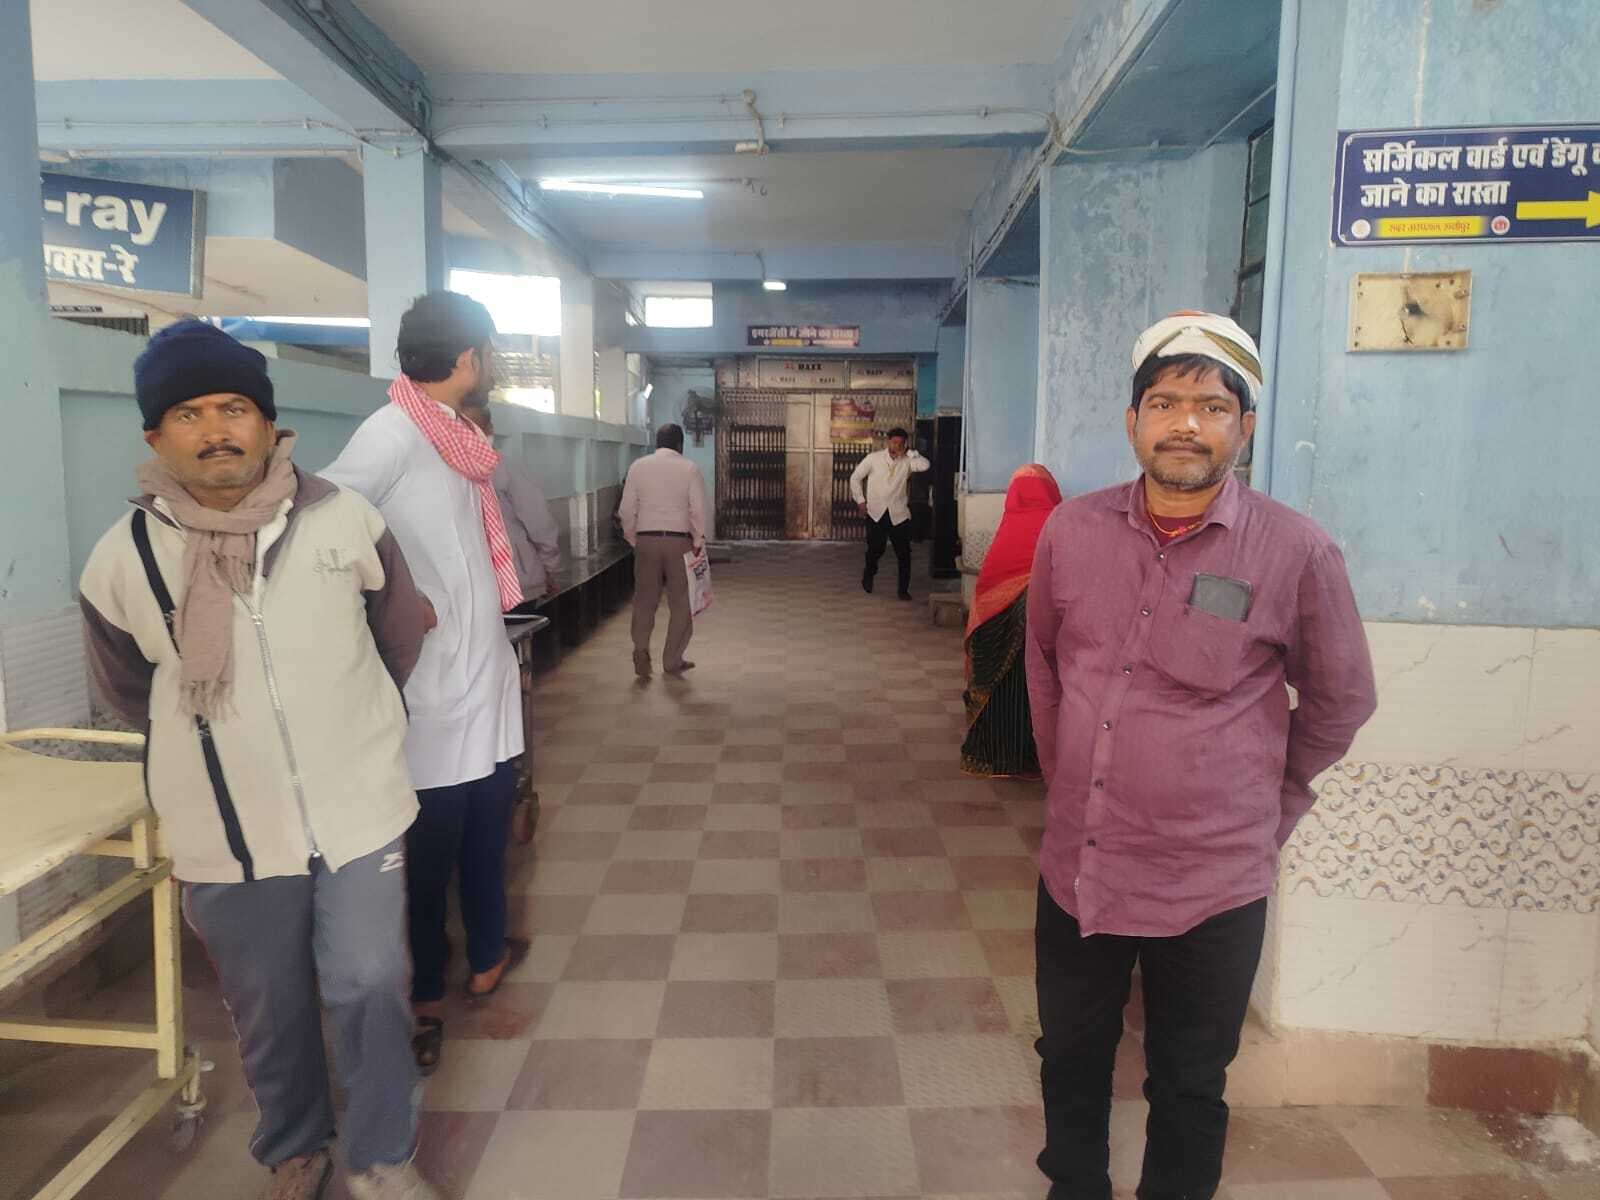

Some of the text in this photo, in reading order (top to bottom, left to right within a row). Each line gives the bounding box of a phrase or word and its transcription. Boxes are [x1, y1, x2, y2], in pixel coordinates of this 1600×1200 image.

[1362, 140, 1463, 173] सर्जिकल
[1466, 137, 1508, 169] वार्ड
[1512, 137, 1550, 168] एवं
[1551, 137, 1588, 176] डेंगू
[1360, 178, 1511, 208] जाने का रास्ता
[42, 191, 167, 245] -ray
